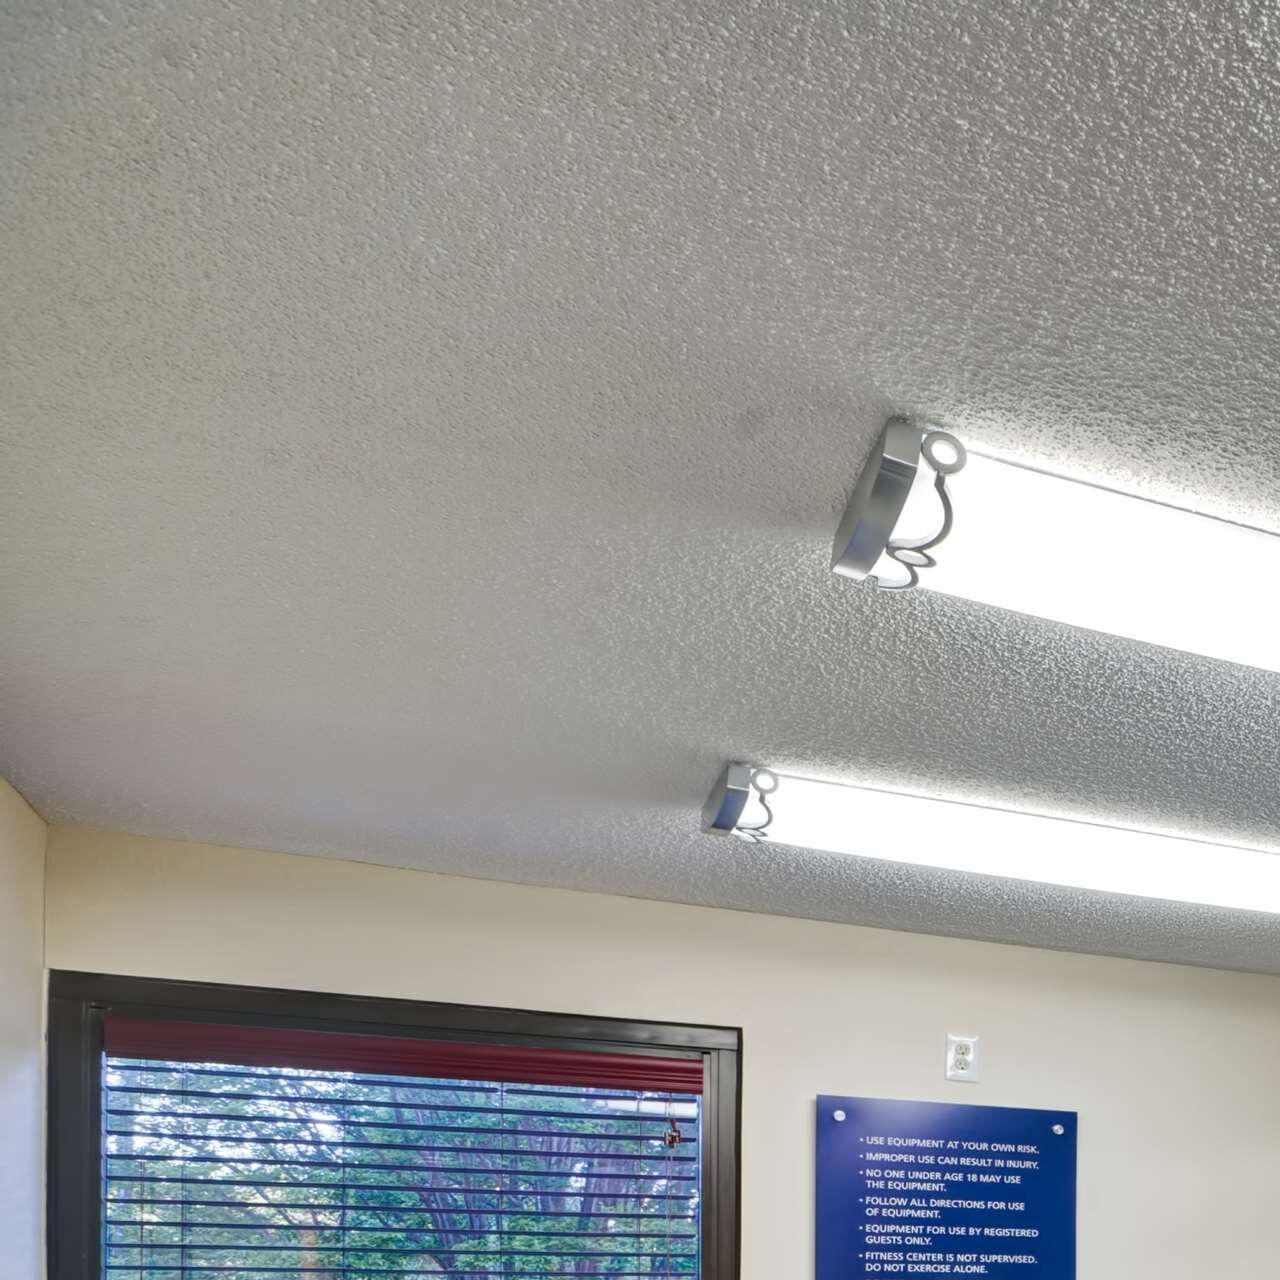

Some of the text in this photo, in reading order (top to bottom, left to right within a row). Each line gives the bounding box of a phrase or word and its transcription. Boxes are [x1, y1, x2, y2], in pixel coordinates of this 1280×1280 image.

[866, 1137, 1039, 1154] USE EQUIPMENT AT YOUR OWN RISK.
[866, 1153, 915, 1163] IMPROPER
[918, 1156, 935, 1164] USE
[938, 1157, 957, 1165] CAN
[960, 1158, 992, 1167] RESULT
[1006, 1160, 1039, 1169] INJURY.
[866, 1169, 1021, 1184] NO ONE UNDER AGE 18 MAY USE
[866, 1180, 947, 1191] THE EQUIPMENT.
[865, 1197, 907, 1206] FOLLOW
[910, 1199, 927, 1207] ALL
[930, 1200, 985, 1209] DIRECTIONS
[865, 1208, 941, 1218] OF EQUIPMENT.
[865, 1225, 924, 1234] EQUIPMENT
[927, 1226, 945, 1234] FOR
[949, 1227, 966, 1235] USE
[984, 1228, 1039, 1237] REGISTERED
[865, 1236, 932, 1245] GUESTS ONLY.
[865, 1252, 1038, 1264] FITNESS CENTER IS NOT SUPERVISED.
[865, 1264, 988, 1273] DO NOT EXERCISE ALONE.
